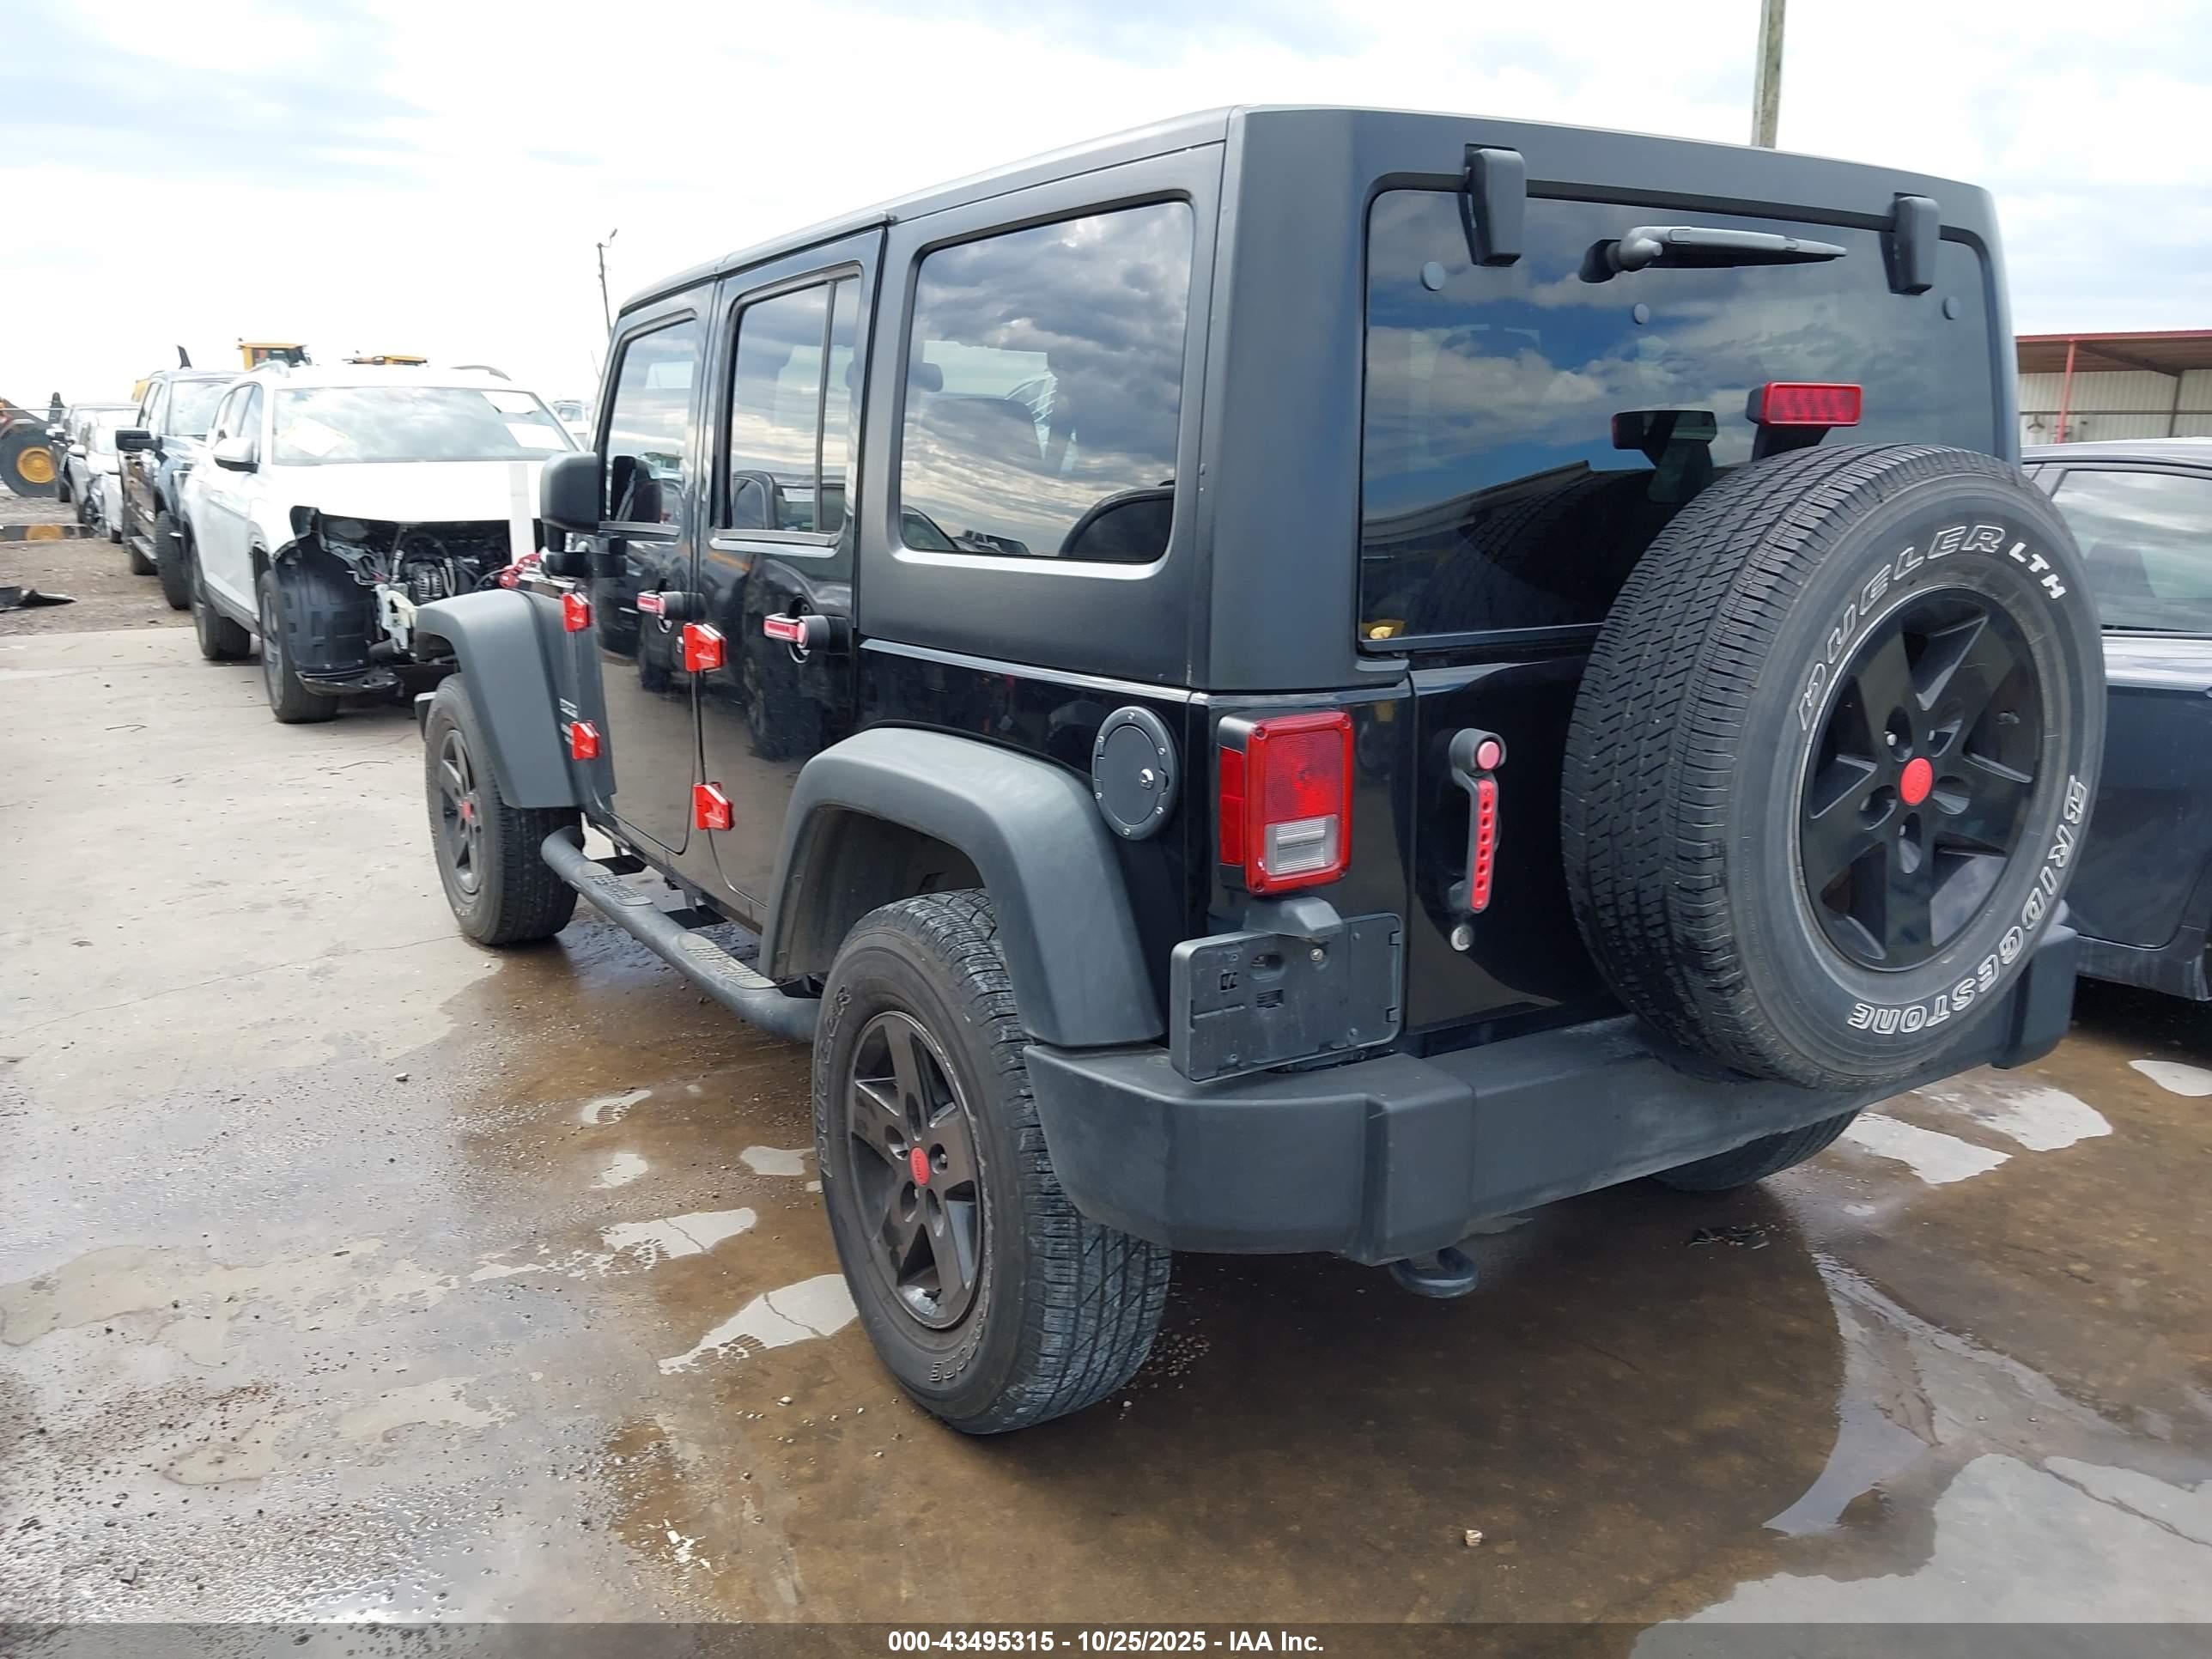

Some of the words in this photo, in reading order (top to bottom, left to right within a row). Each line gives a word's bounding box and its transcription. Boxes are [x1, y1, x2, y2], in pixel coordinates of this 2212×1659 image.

[1797, 524, 2006, 732] DUELER
[2008, 541, 2067, 599] LTH
[1846, 774, 2087, 1035] BRIDGESTONE
